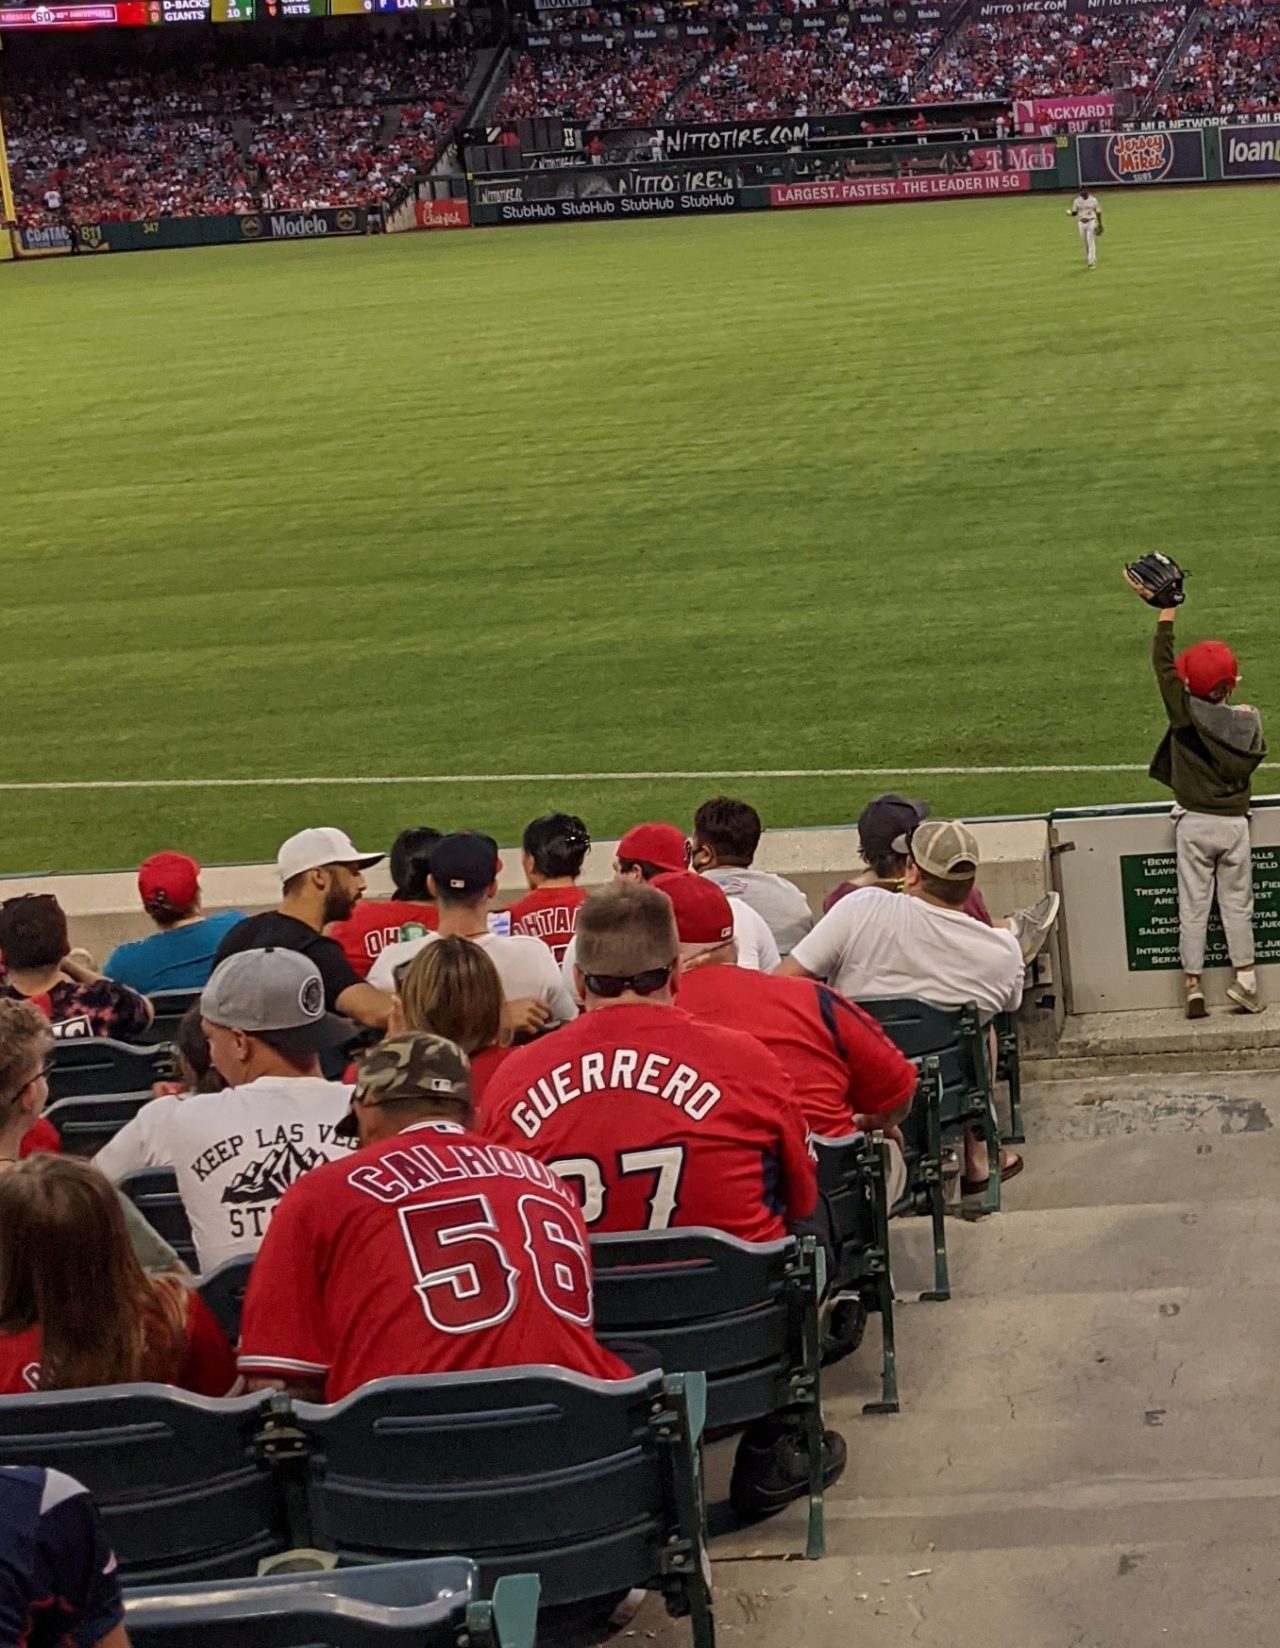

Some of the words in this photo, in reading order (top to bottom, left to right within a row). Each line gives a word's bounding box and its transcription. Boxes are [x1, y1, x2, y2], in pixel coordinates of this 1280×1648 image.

[164, 11, 205, 21] GIANTS
[283, 5, 310, 14] METS
[1045, 104, 1106, 120] ACKYARD
[666, 122, 809, 153] NITTOTIRE.COM
[1114, 135, 1165, 155] Jersey
[777, 185, 839, 202] LARGEST.
[842, 181, 900, 198] FASTEST.
[903, 179, 927, 194] THE
[932, 176, 982, 193] LEADER
[985, 176, 999, 189] IN
[1001, 174, 1020, 188] 5G
[503, 205, 556, 219] StubHub
[561, 201, 615, 216] StubHub
[620, 198, 675, 212] StubHub
[680, 194, 735, 209] StubHub
[26, 224, 70, 242] CONTAC
[81, 224, 102, 241] 811
[271, 215, 328, 237] Modelo
[1147, 858, 1176, 866] BEWA
[1251, 851, 1275, 860] ALLS
[1134, 887, 1178, 897] TRESPAS
[1154, 897, 1175, 906] ARE
[1151, 916, 1180, 925] PELIG
[1253, 911, 1278, 920] OTAS
[1138, 926, 1180, 936] SALIEND
[1136, 946, 1179, 955] INTRUSO
[511, 1049, 721, 1138] GUERRERO
[191, 1135, 244, 1182] KEEP
[255, 1123, 304, 1148] LAS
[229, 1206, 276, 1238] ST
[398, 1194, 593, 1333] 56
